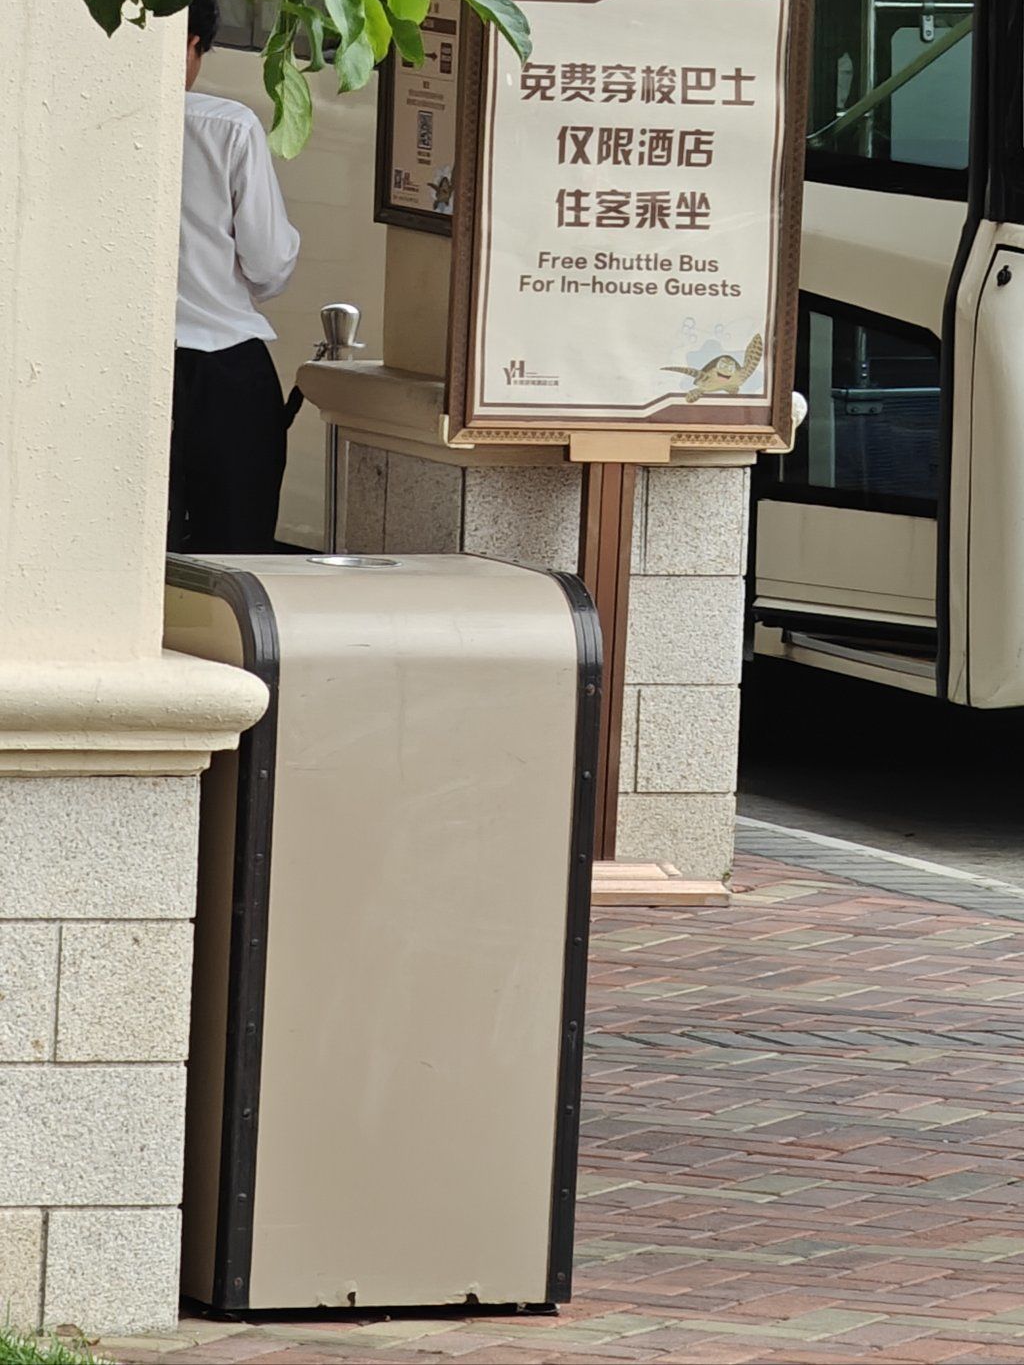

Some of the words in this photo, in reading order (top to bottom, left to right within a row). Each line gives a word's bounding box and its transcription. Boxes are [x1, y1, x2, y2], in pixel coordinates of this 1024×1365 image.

[520, 62, 756, 106] 免费穿梭巴士
[557, 125, 715, 168] 仅限酒店
[555, 188, 711, 230] 住客乘坐
[538, 251, 588, 270] Free
[593, 252, 673, 271] Shuttle
[679, 254, 719, 273] Bus
[519, 275, 555, 293] For
[561, 275, 658, 295] In-house
[665, 278, 742, 297] Guests
